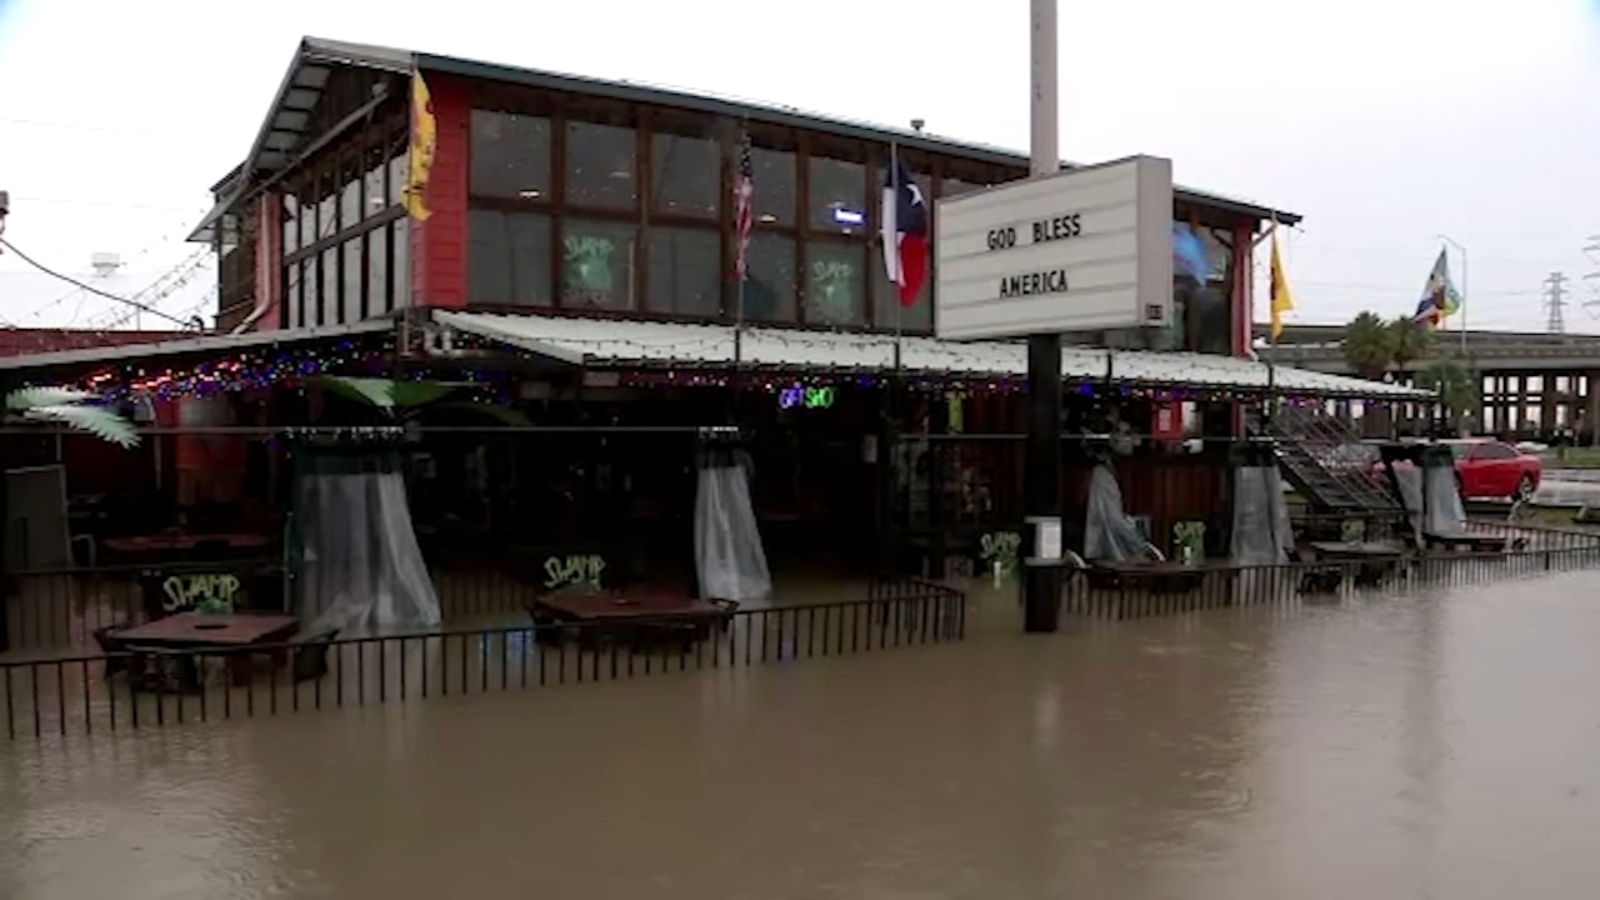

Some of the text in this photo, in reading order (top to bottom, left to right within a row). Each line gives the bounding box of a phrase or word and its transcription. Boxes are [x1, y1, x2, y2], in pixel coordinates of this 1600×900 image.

[987, 214, 1082, 250] GOD BLESS
[1000, 270, 1068, 298] AMERICA
[543, 554, 606, 589] SWAMP
[163, 574, 240, 612] SWAMP
